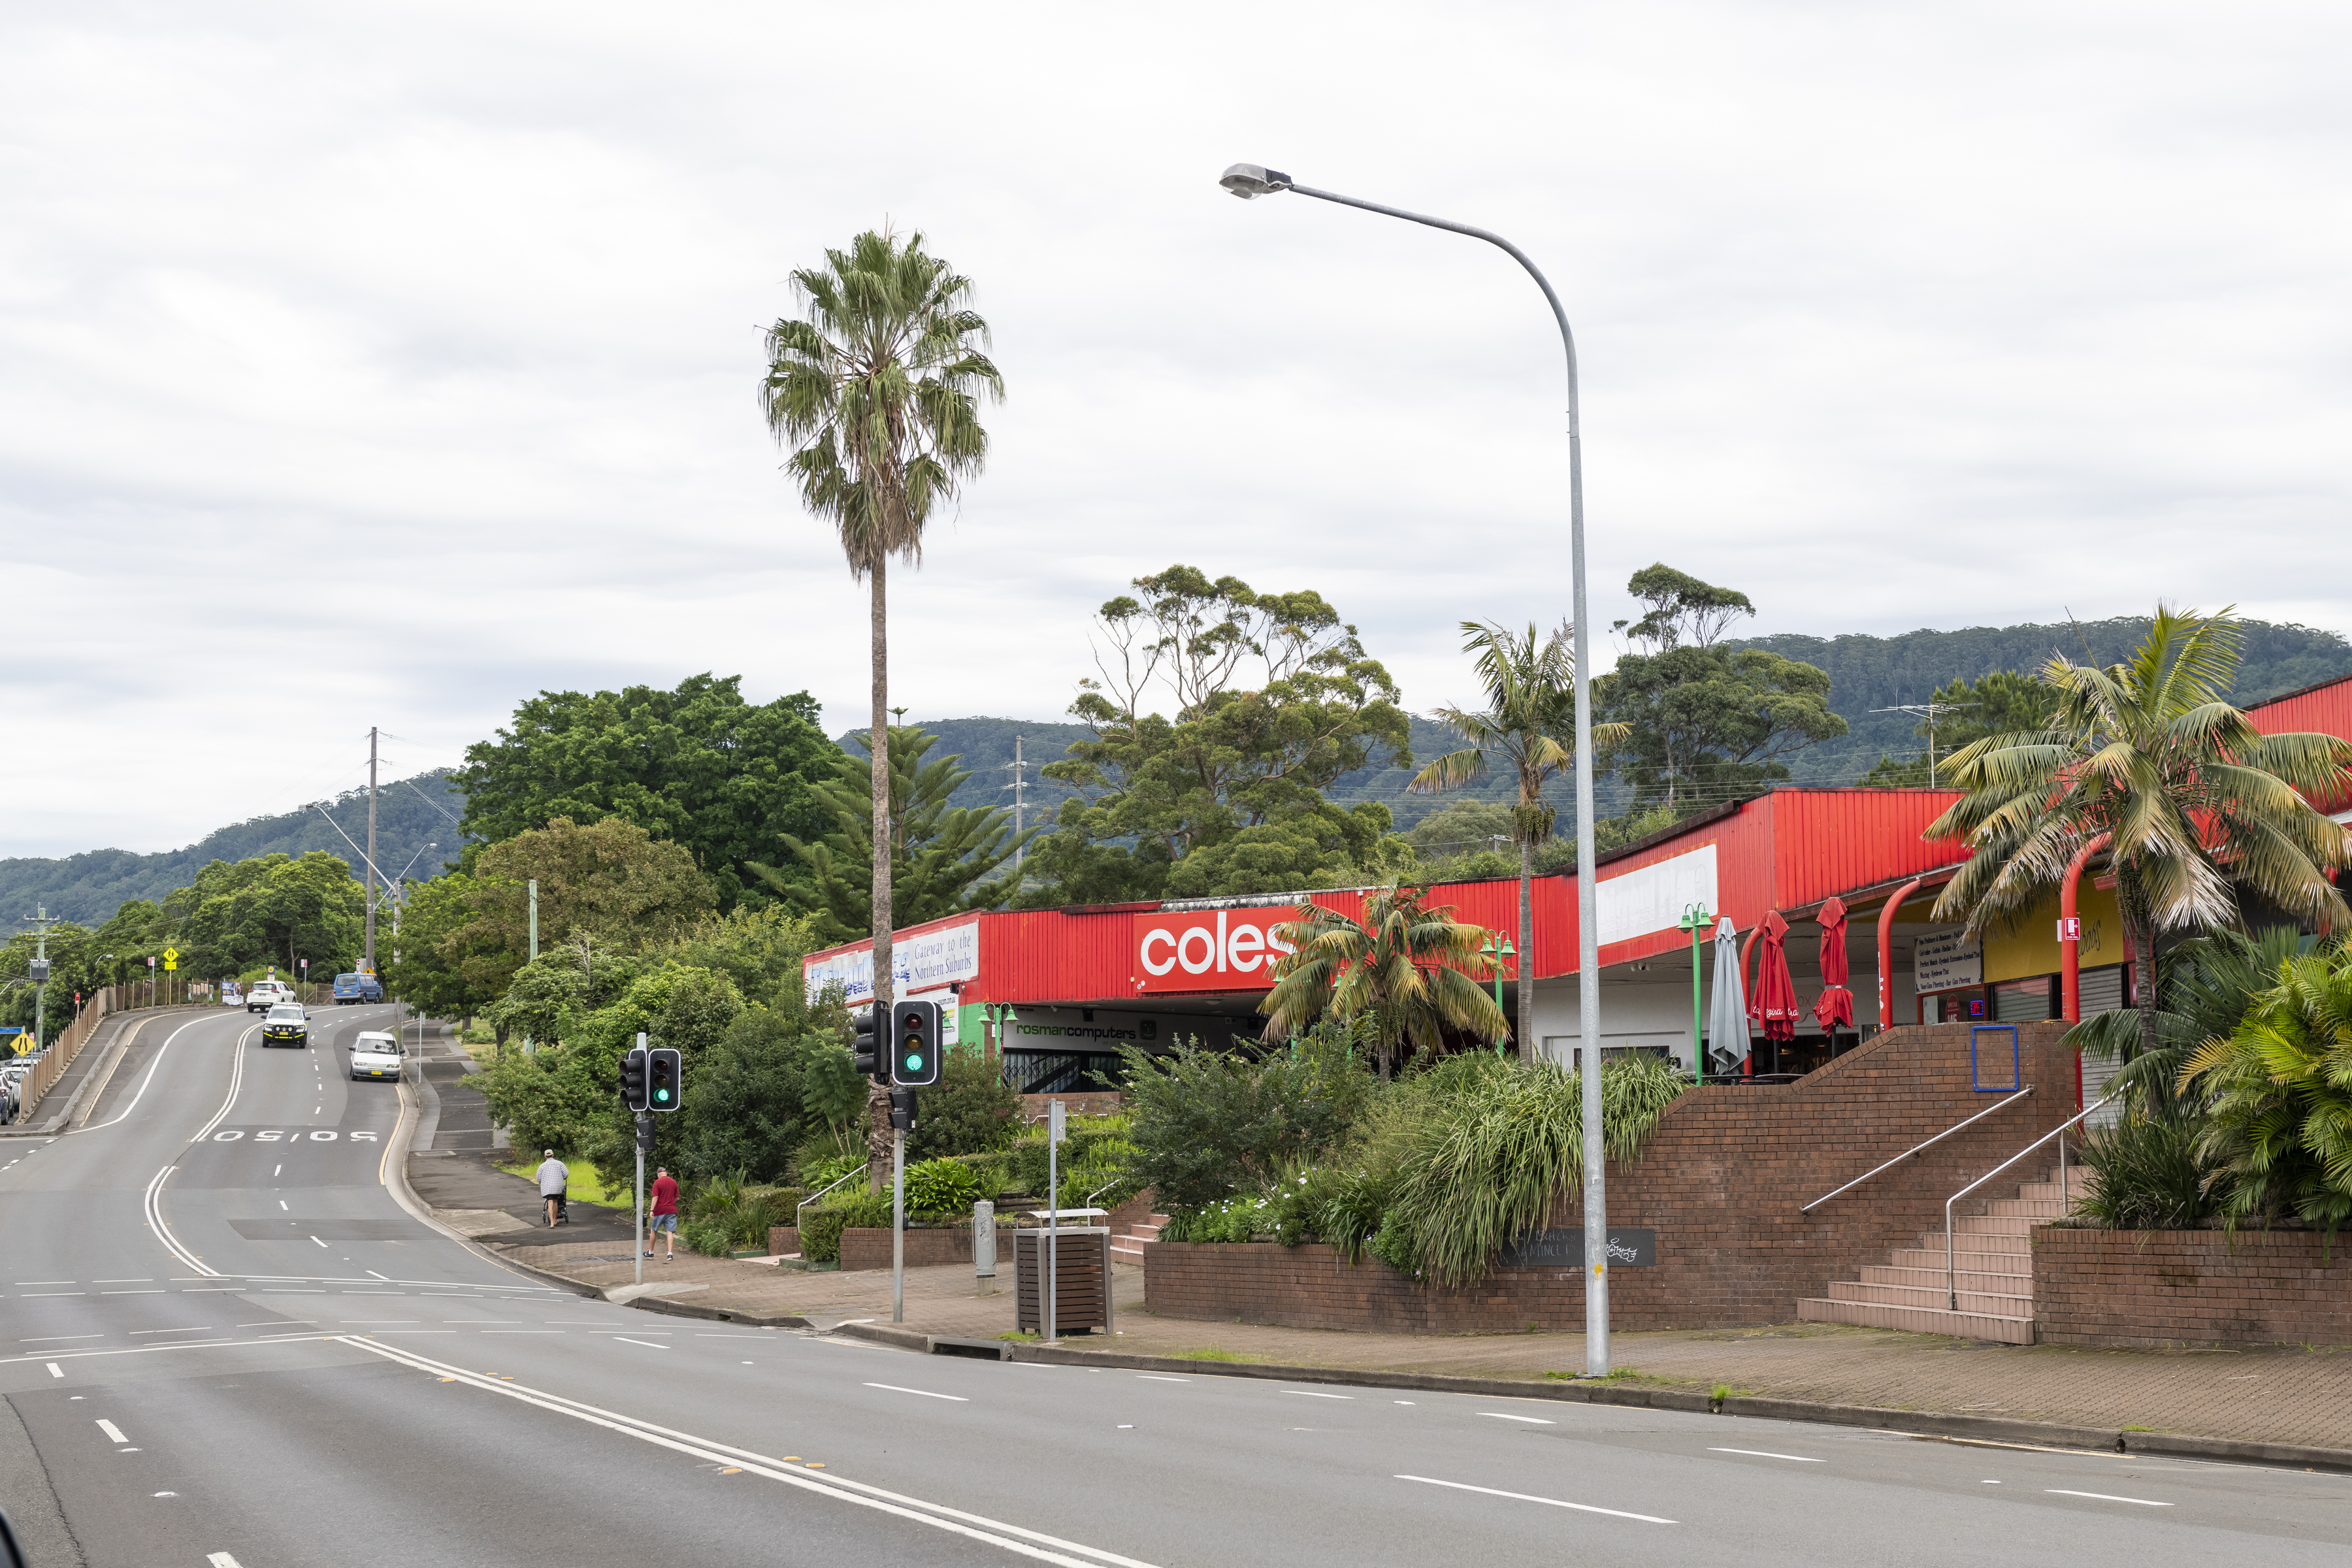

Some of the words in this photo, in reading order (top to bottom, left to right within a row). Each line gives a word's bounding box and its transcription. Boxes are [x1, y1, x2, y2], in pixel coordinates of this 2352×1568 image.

[915, 941, 944, 960] Gateway
[948, 939, 955, 951] to
[960, 930, 971, 949] the
[1141, 911, 1298, 975] coles
[915, 963, 944, 981] Northern
[945, 952, 972, 973] Suburbs
[1016, 1024, 1136, 1043] rosmancomputers
